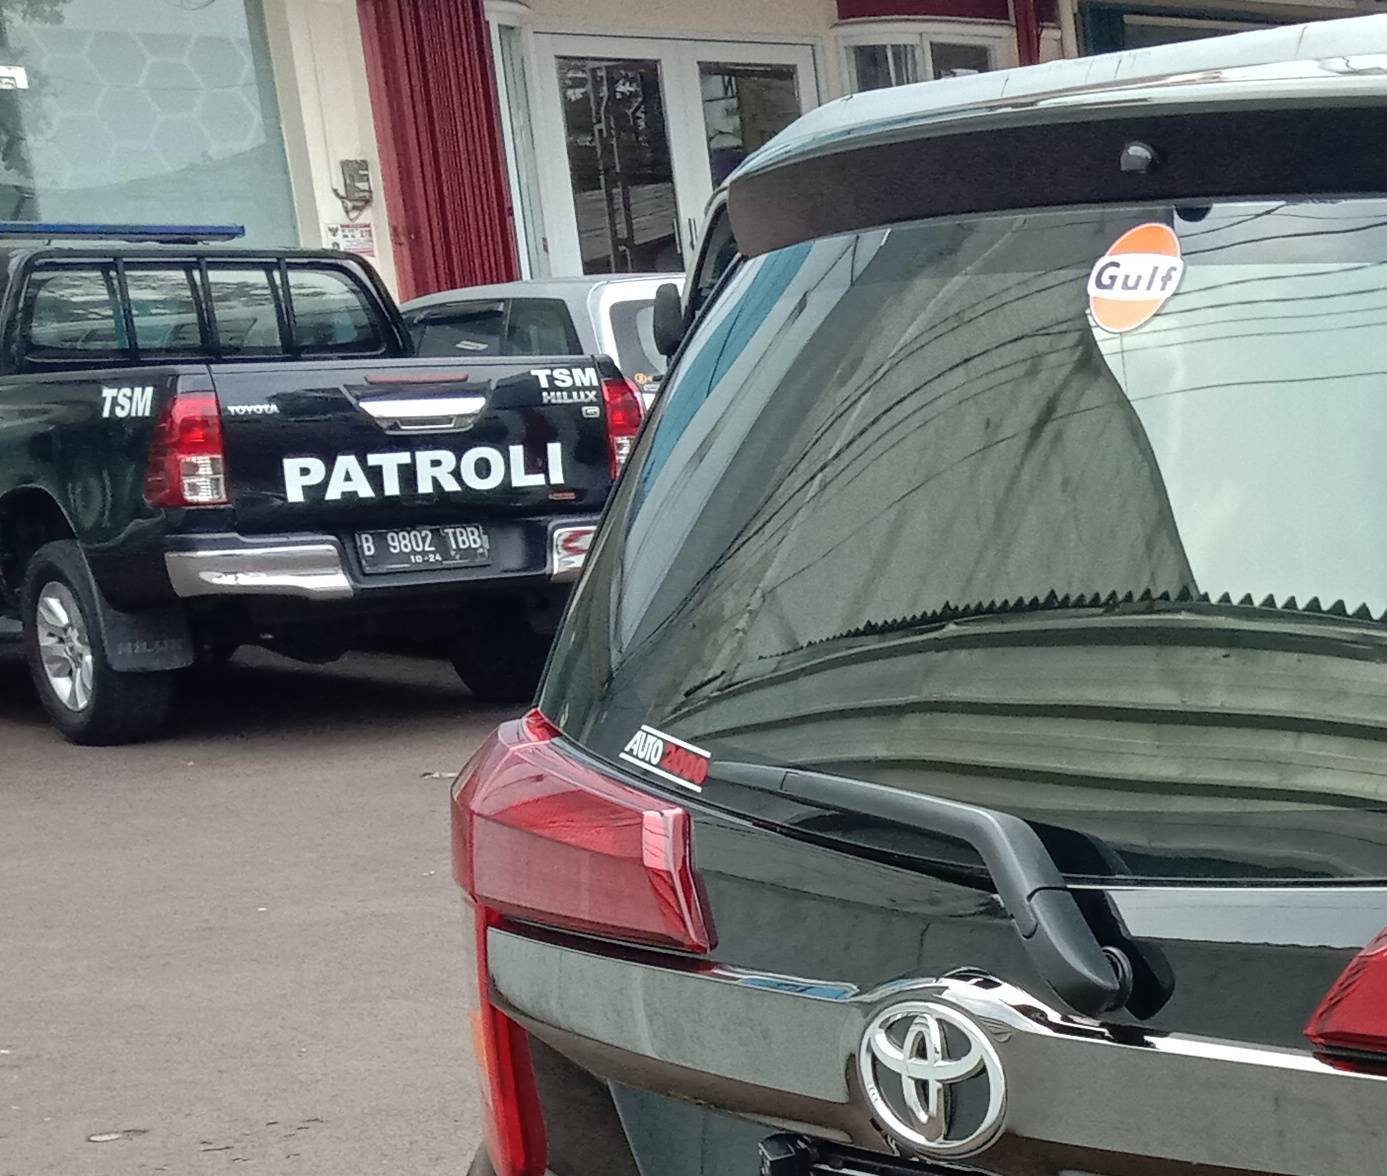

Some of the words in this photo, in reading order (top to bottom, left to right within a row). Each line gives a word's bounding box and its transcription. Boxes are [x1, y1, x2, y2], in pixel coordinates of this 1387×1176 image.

[1095, 260, 1178, 292] Gulf
[530, 367, 600, 389] TSM
[101, 385, 154, 419] TSM
[227, 403, 280, 416] TOYOTA
[541, 390, 598, 404] HILUX
[282, 442, 565, 504] PATROLI
[360, 533, 376, 556] B
[386, 529, 436, 554] 9802
[443, 526, 482, 550] TBB
[623, 729, 664, 766] AUTO
[660, 742, 710, 785] 2000
